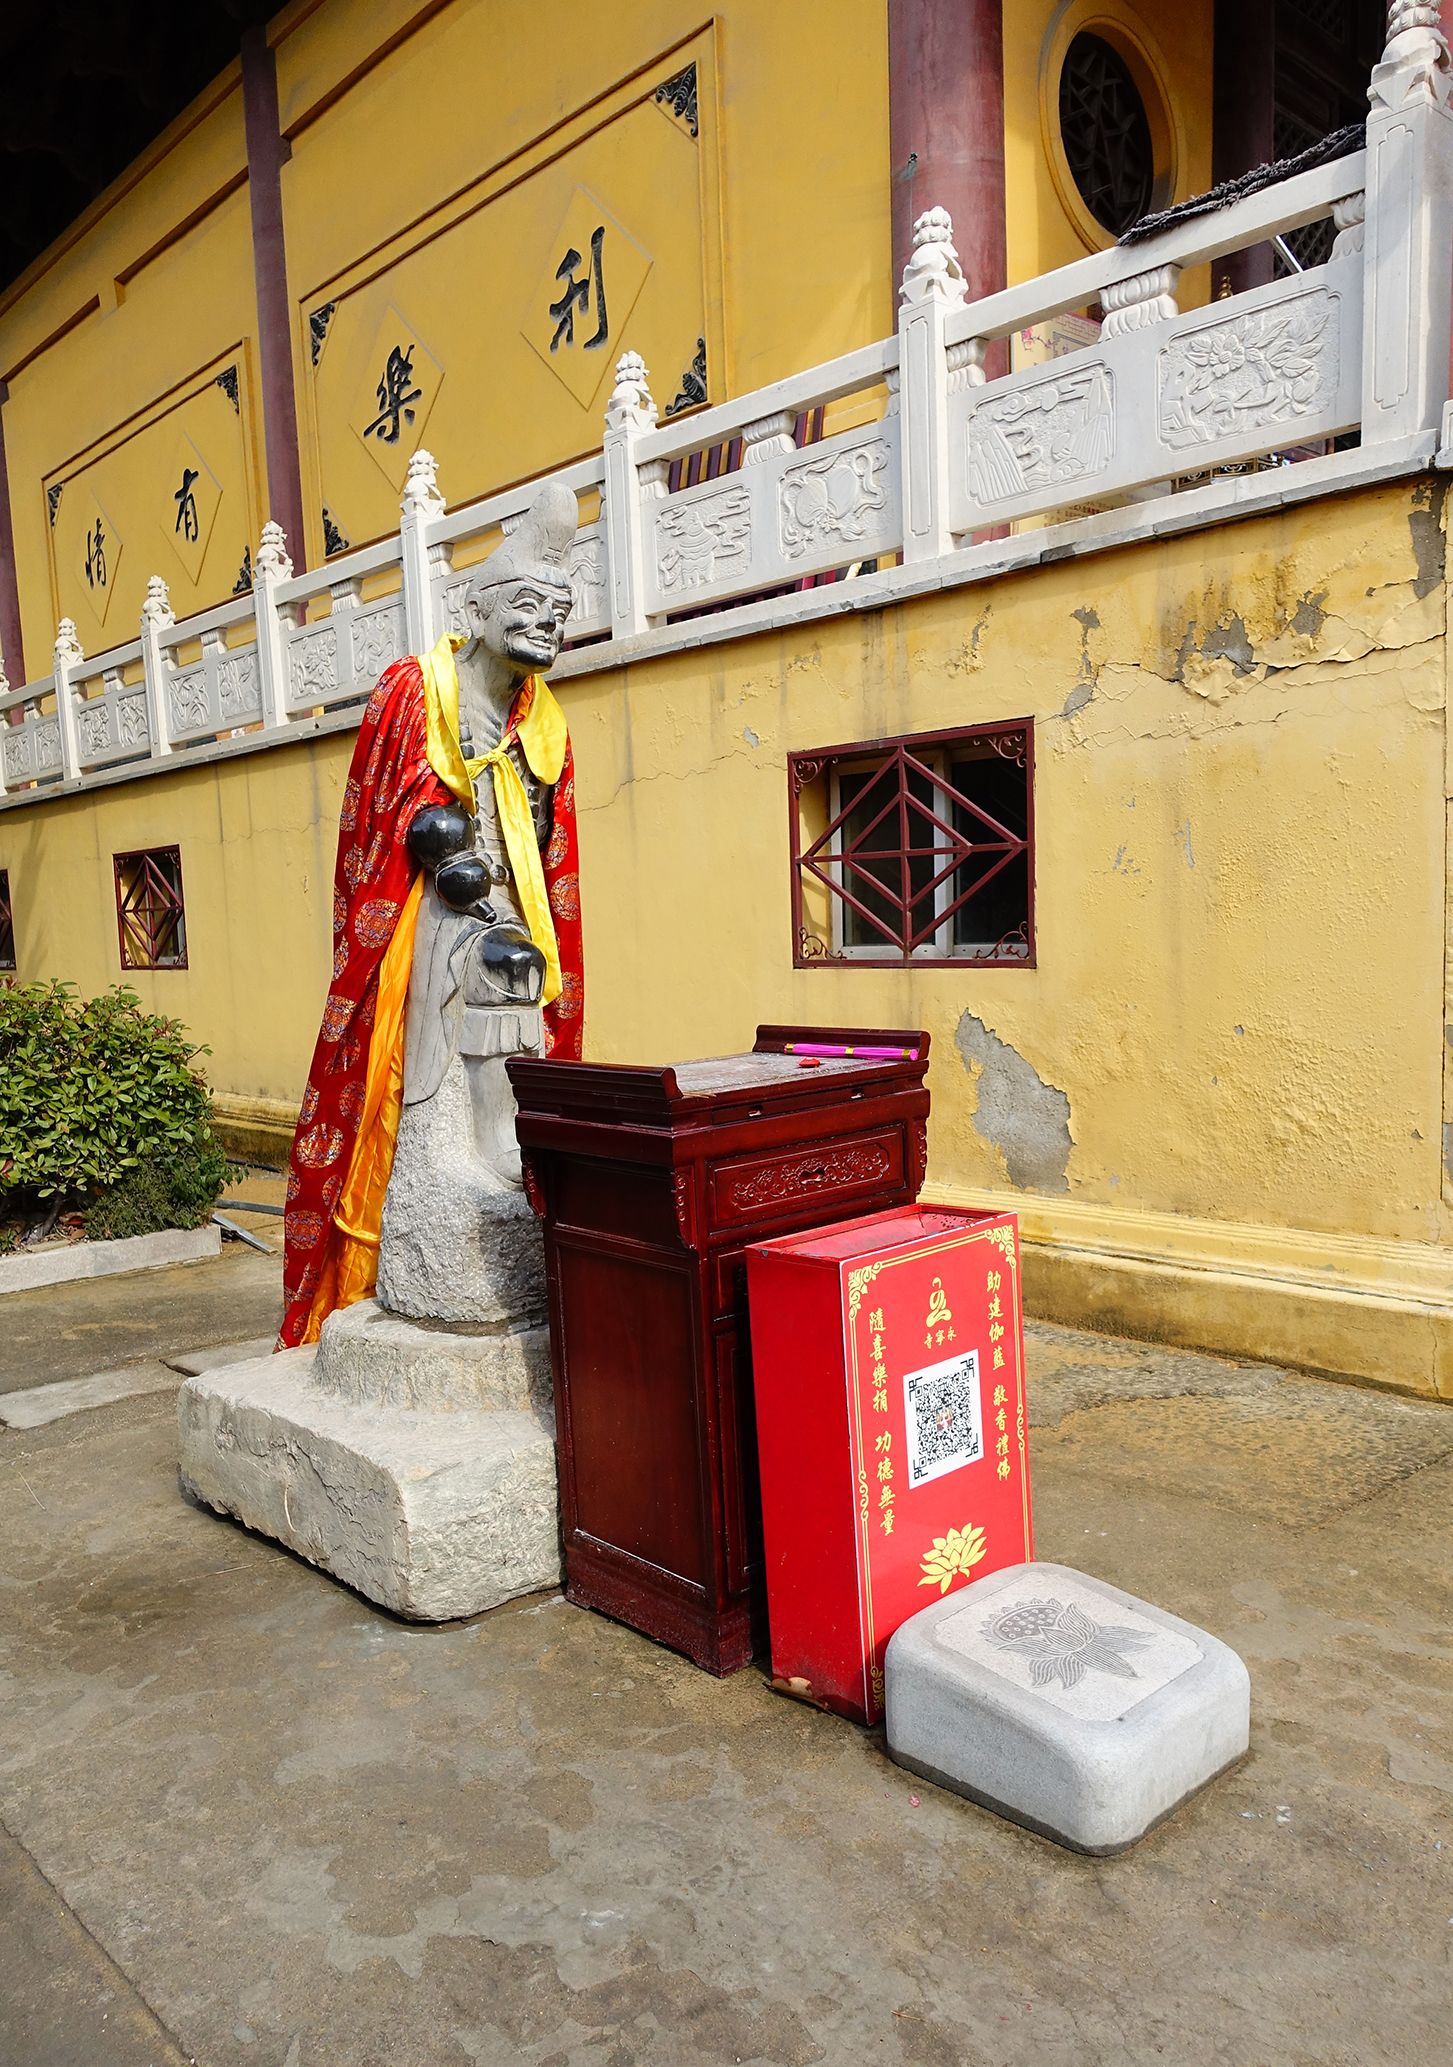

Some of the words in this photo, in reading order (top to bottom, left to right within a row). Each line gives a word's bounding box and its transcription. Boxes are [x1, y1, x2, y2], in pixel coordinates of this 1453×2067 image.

[549, 225, 609, 353] 利
[363, 344, 423, 445] 樂
[85, 517, 107, 590] 情
[174, 468, 200, 543] 有
[874, 1430, 896, 1537] 功德無量
